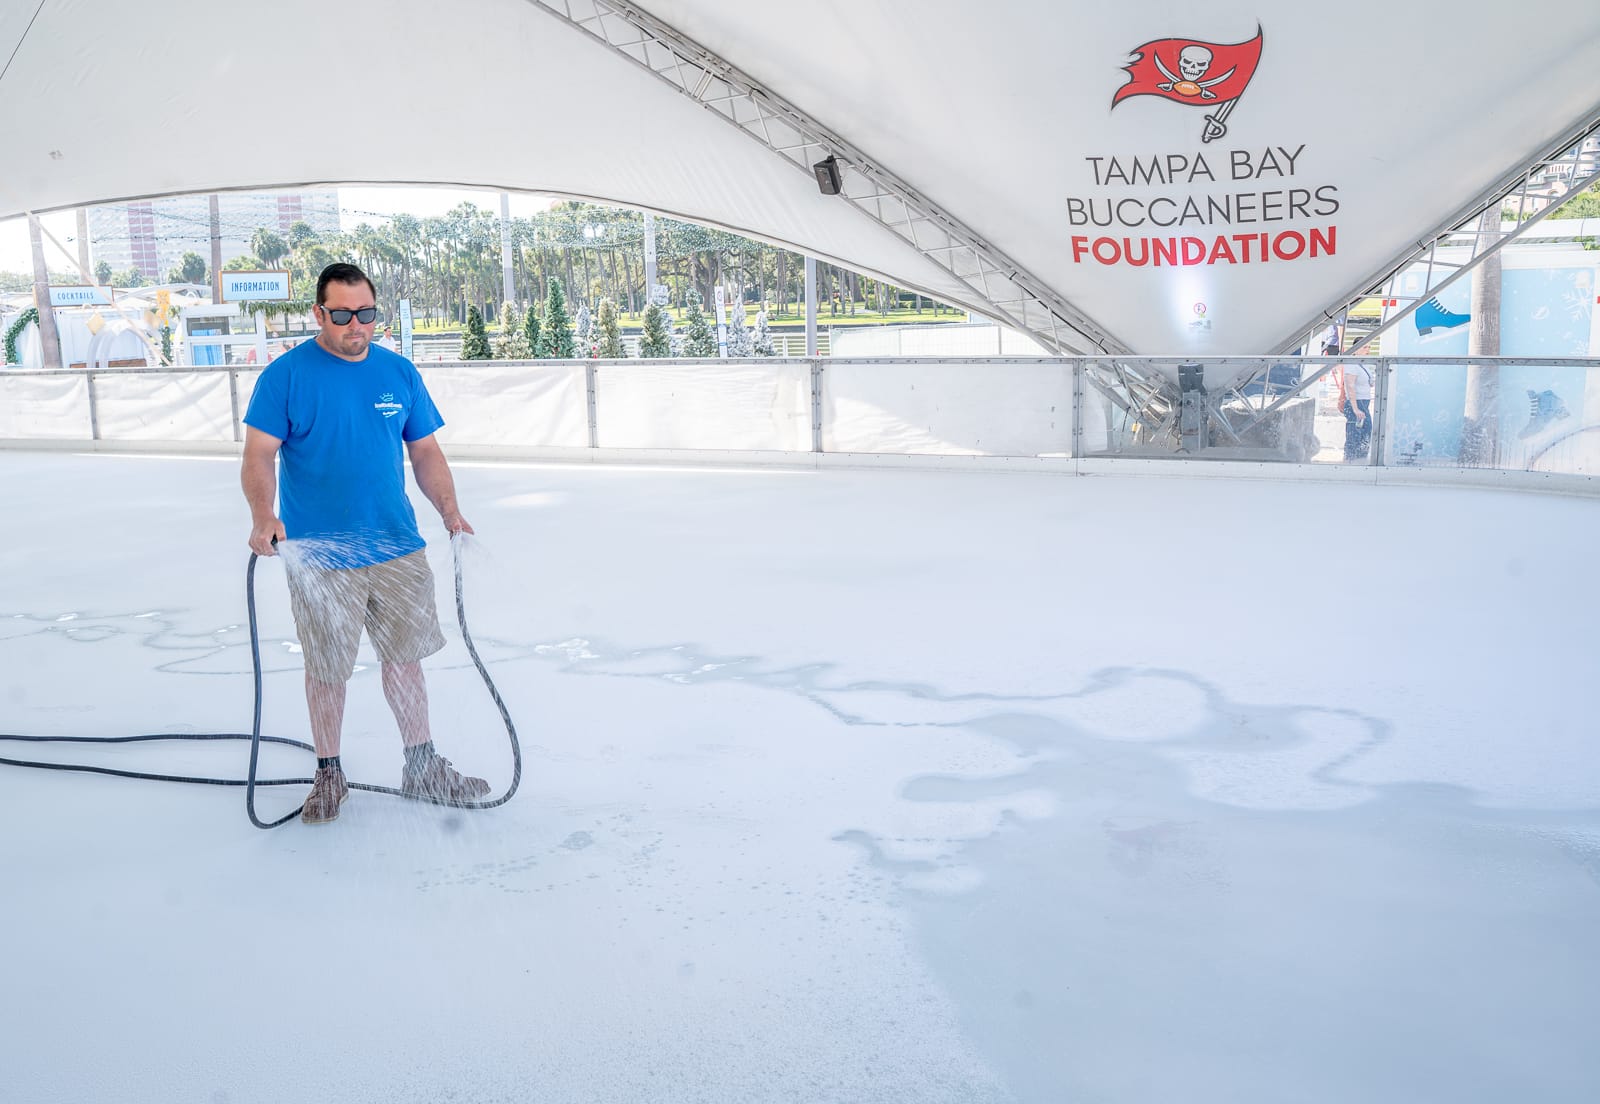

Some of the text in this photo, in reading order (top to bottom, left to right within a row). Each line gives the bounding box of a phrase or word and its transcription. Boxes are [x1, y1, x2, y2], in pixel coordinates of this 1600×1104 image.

[1085, 144, 1306, 186] TAMPA BAY
[1066, 185, 1340, 227] BUCCANEERS
[1071, 225, 1337, 267] FOUNDATION
[57, 292, 95, 300] COCKTAILS
[231, 281, 280, 293] INFORMATION
